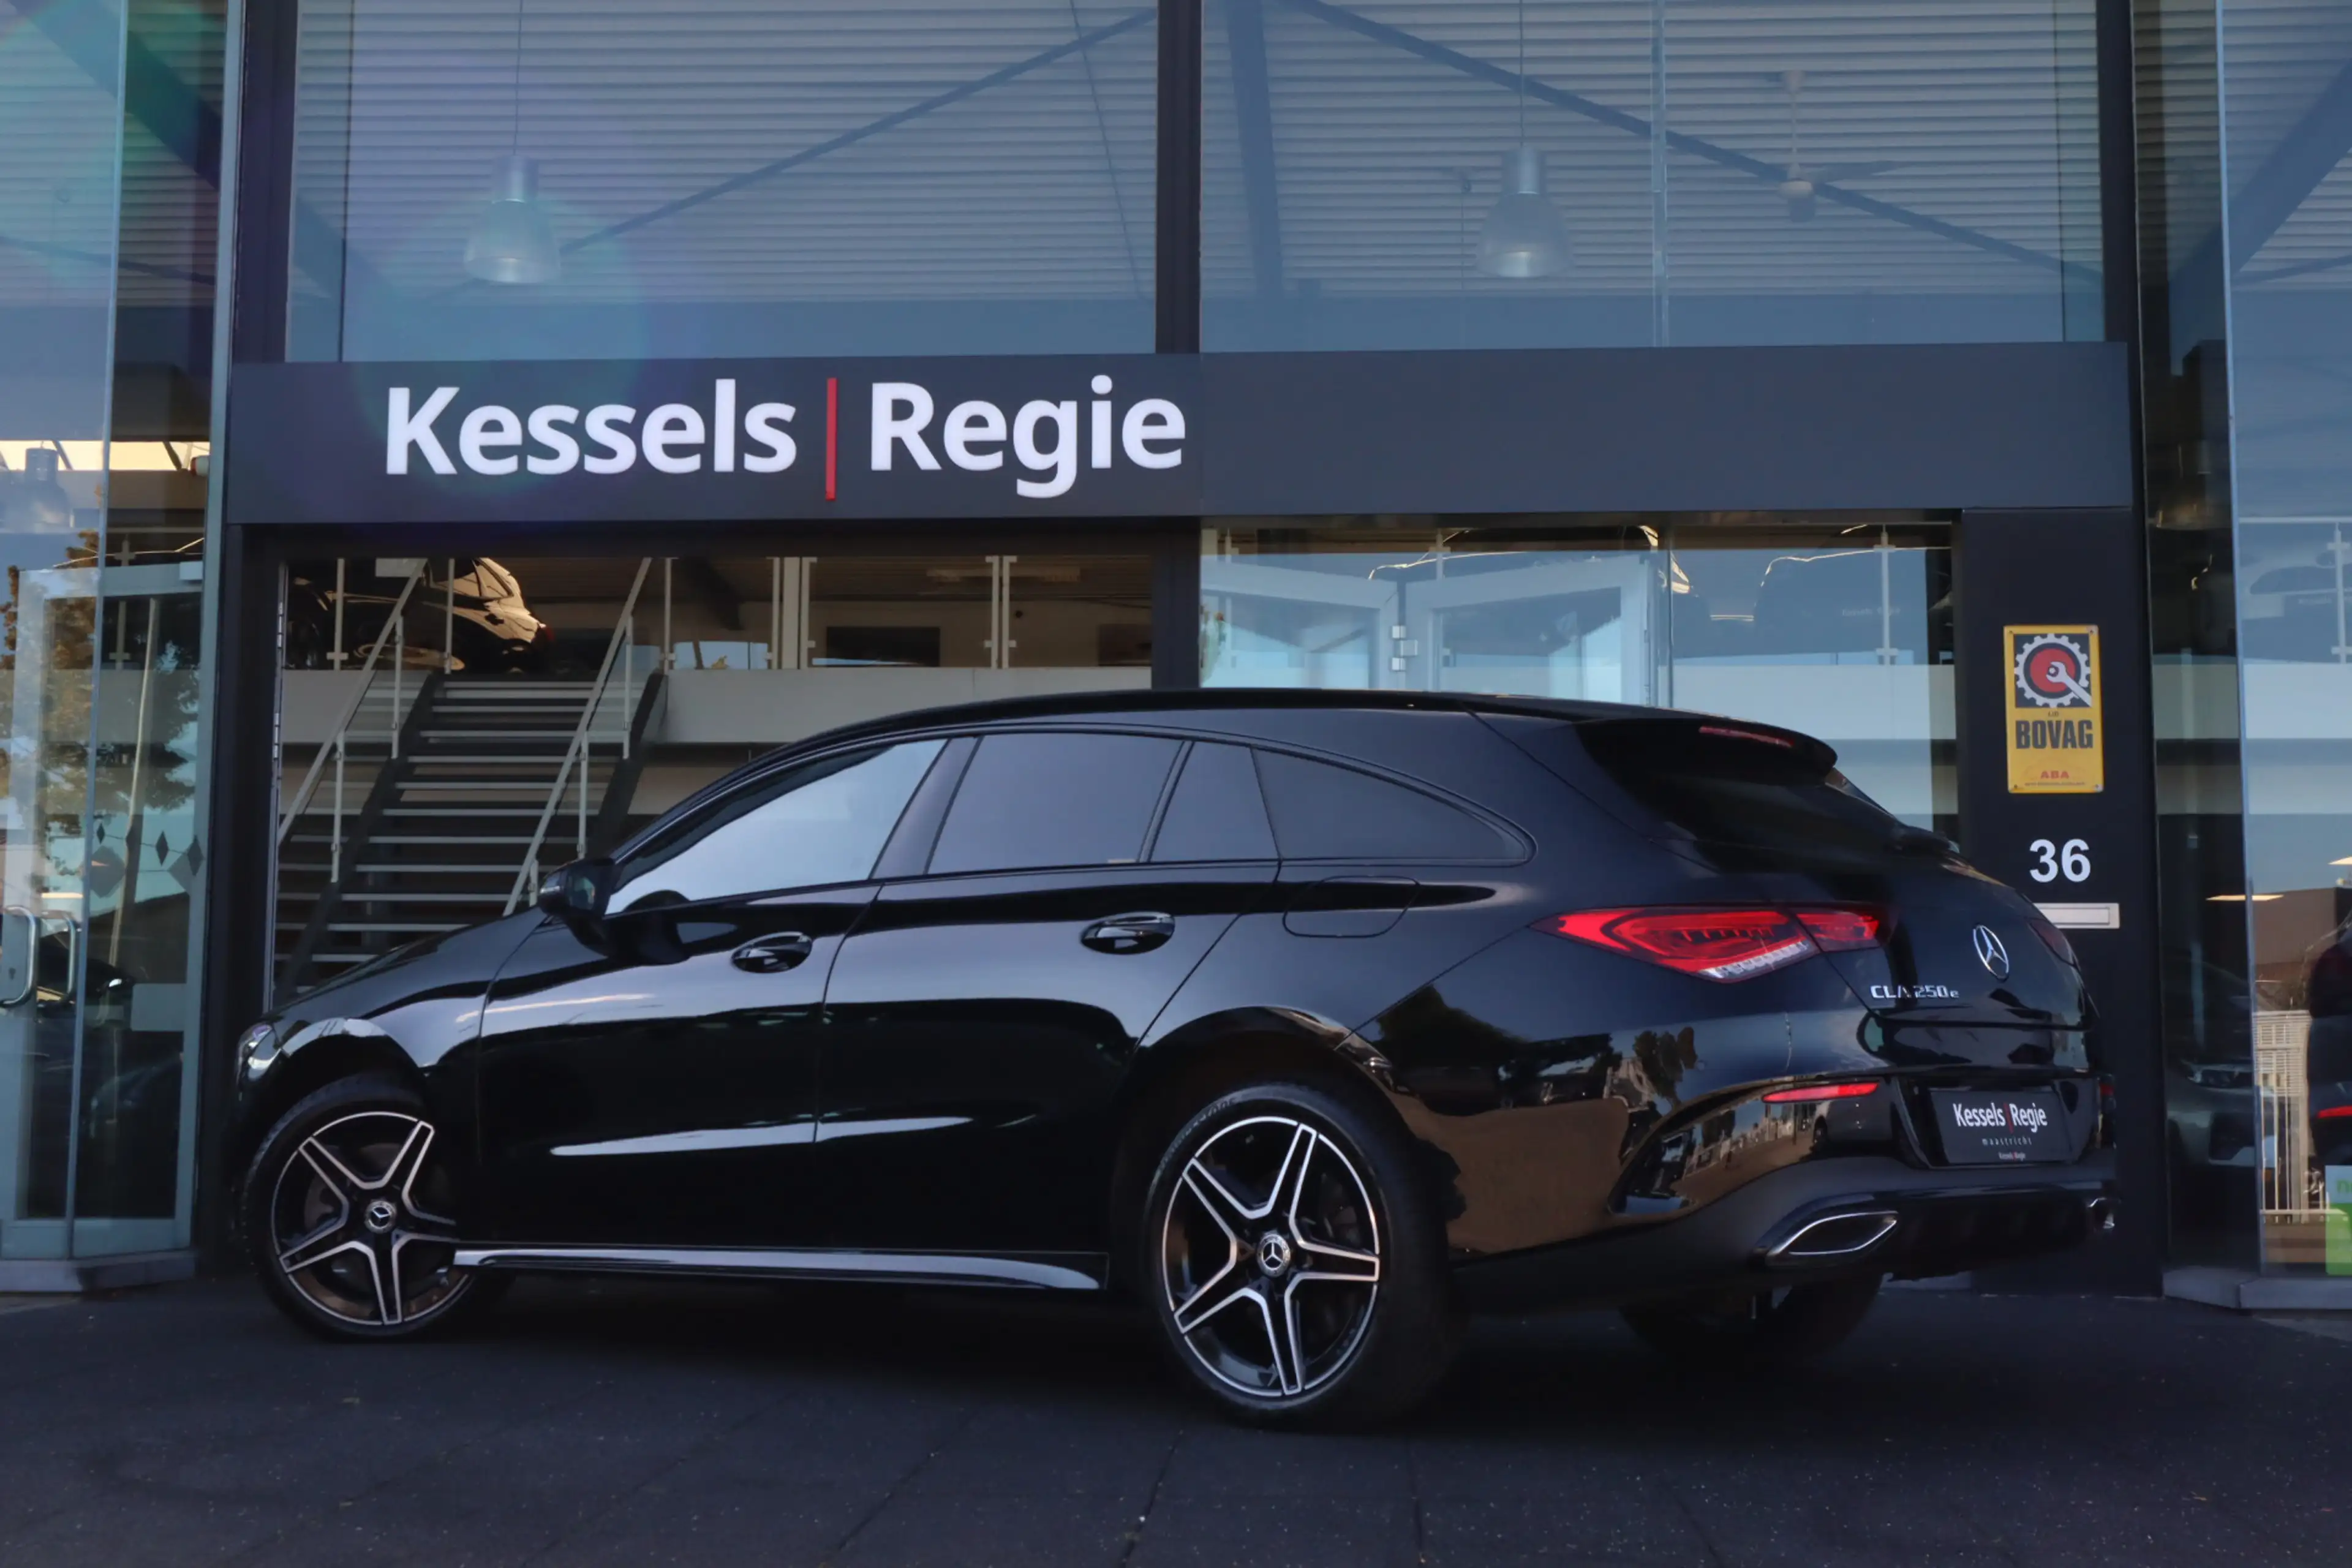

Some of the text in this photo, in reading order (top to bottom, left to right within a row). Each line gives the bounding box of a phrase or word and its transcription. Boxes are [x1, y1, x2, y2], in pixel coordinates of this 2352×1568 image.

[386, 375, 1185, 498] Kessels Regie
[2016, 719, 2094, 749] BOVAG
[2029, 839, 2091, 883] 36
[1871, 985, 1912, 998] CLA
[1952, 1102, 2048, 1133] Kessels Regie
